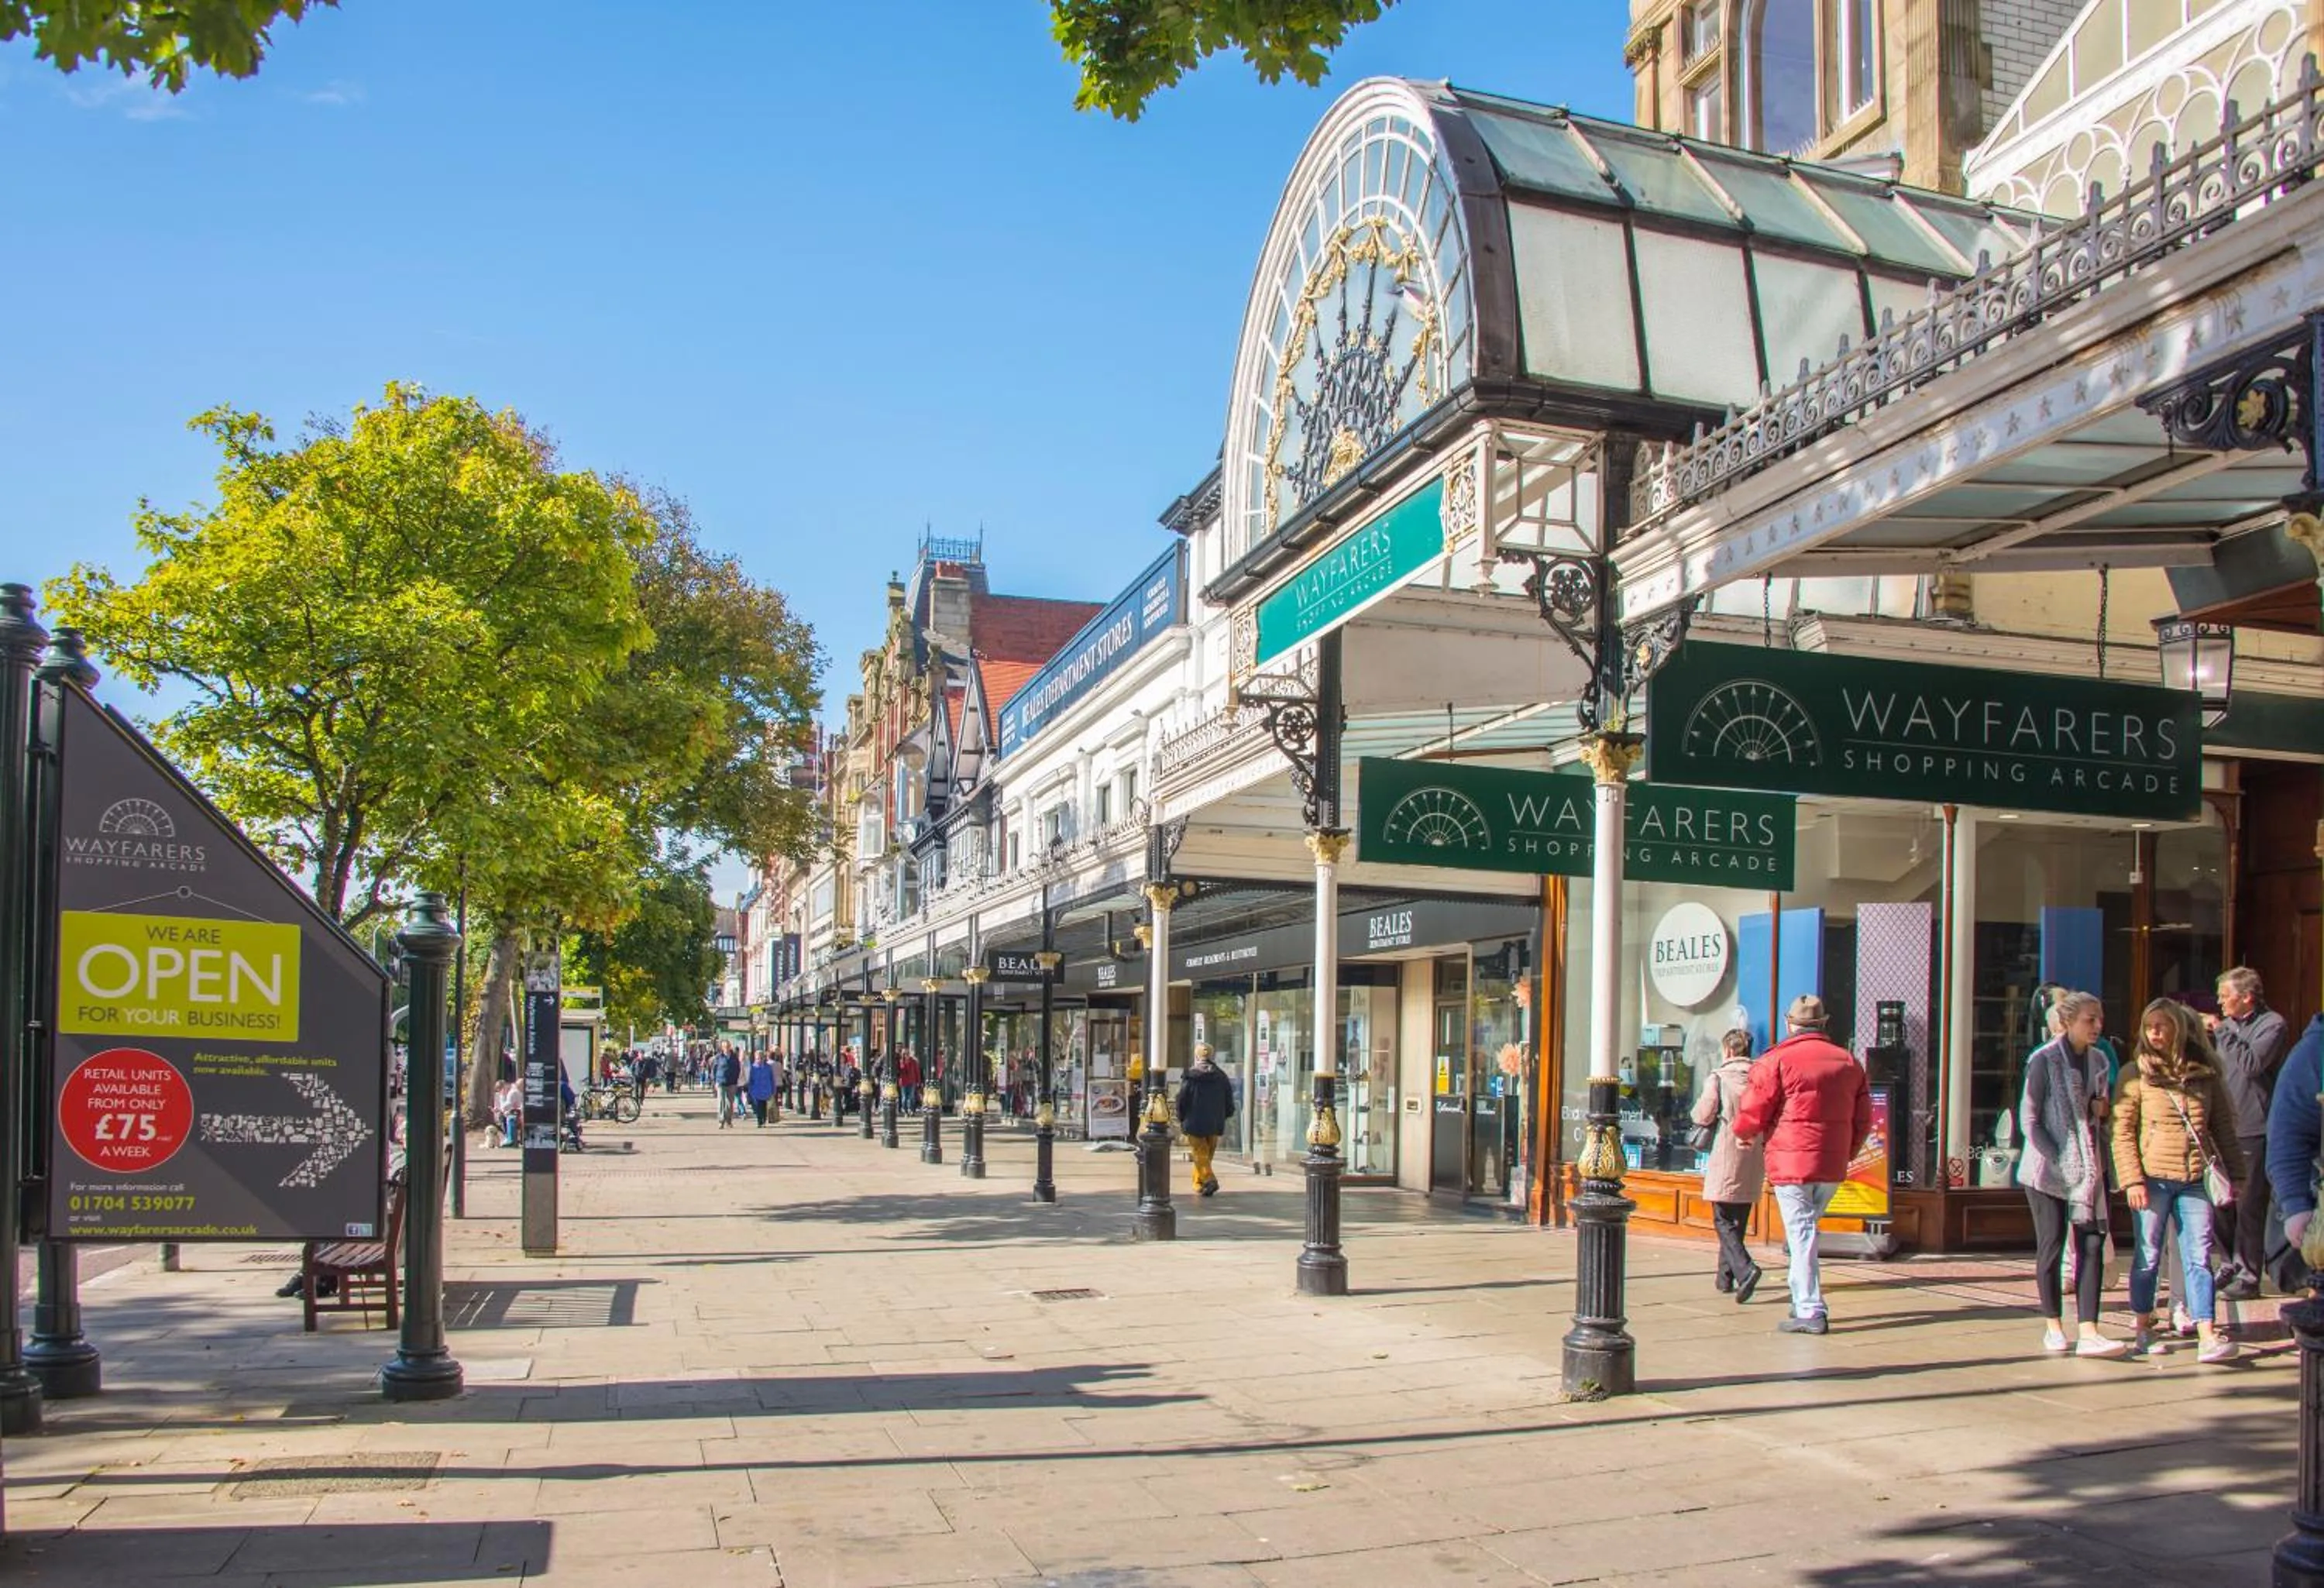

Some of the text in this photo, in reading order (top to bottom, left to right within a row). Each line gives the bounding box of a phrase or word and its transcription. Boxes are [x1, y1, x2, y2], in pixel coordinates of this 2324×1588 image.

[1295, 522, 1391, 609] WAYFARERS
[1045, 643, 1097, 708] DEPARTMENT
[1097, 610, 1133, 666] STORES
[1842, 687, 2177, 761] WAYFARERS
[1843, 749, 2179, 795] SHOPPING ARCADE
[1507, 792, 1775, 846] WAARERS
[65, 837, 205, 861] WAYFARERS
[65, 857, 206, 872] SHOPPING ARCADE
[1670, 851, 1776, 872] ARCADE
[146, 925, 222, 944] WE ARE
[1369, 911, 1412, 938] BEALES
[1655, 933, 1721, 963] BEALES
[77, 943, 282, 1006] OPEN
[78, 1006, 281, 1029] FOR YOUR BUSINESS!
[194, 1067, 217, 1075] now
[255, 1054, 308, 1066] affordable
[311, 1057, 338, 1067] units
[83, 1068, 171, 1081] RETAIL UNITS
[93, 1084, 162, 1095] AVAILABLE
[88, 1098, 167, 1110] FROM ONLY
[95, 1113, 156, 1141] £75
[100, 1146, 152, 1157] A WEEK
[70, 1182, 86, 1191] For
[115, 1182, 168, 1191] information
[169, 1182, 186, 1192] call
[69, 1195, 196, 1211] 01704 539077
[69, 1224, 258, 1237] www.wayfarersarcade.co.uk
